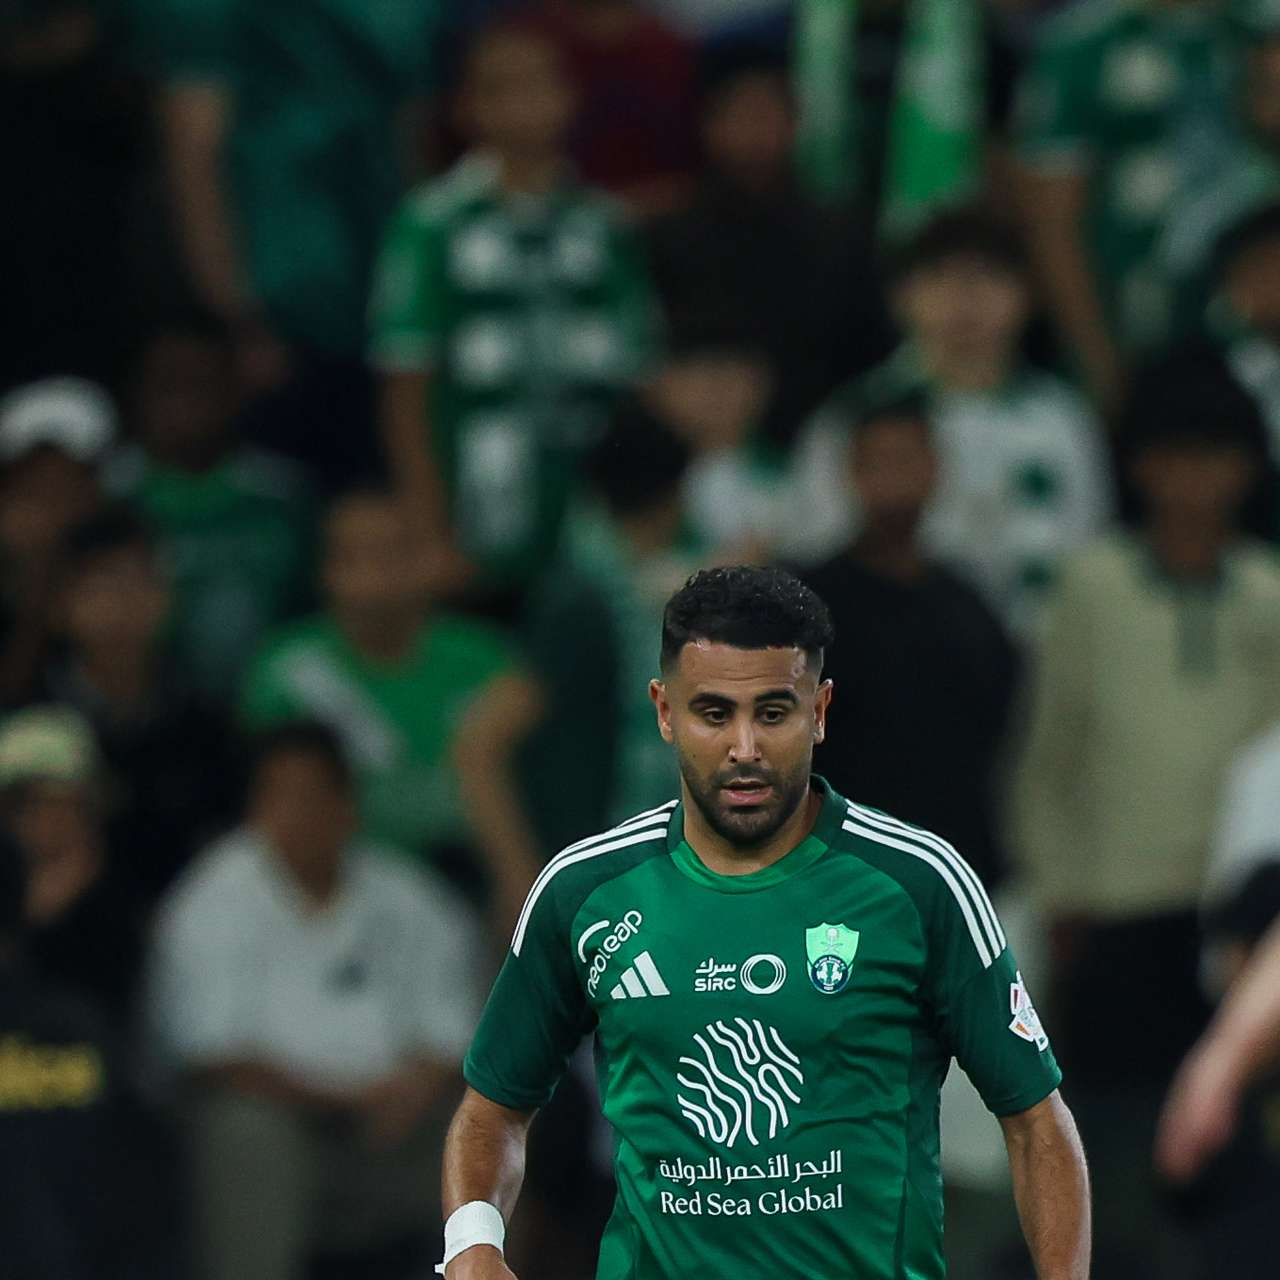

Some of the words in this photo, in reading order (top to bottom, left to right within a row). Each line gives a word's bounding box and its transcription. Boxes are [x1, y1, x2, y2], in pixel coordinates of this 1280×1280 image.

[587, 909, 643, 998] neoleap
[695, 957, 737, 977] سرك
[694, 977, 737, 992] SIRC
[659, 1156, 722, 1187] الدولية
[724, 1153, 790, 1186] الأحمر
[792, 1149, 842, 1183] البحر
[660, 1191, 703, 1215] Red
[706, 1192, 752, 1216] Sea
[758, 1183, 843, 1215] Global
